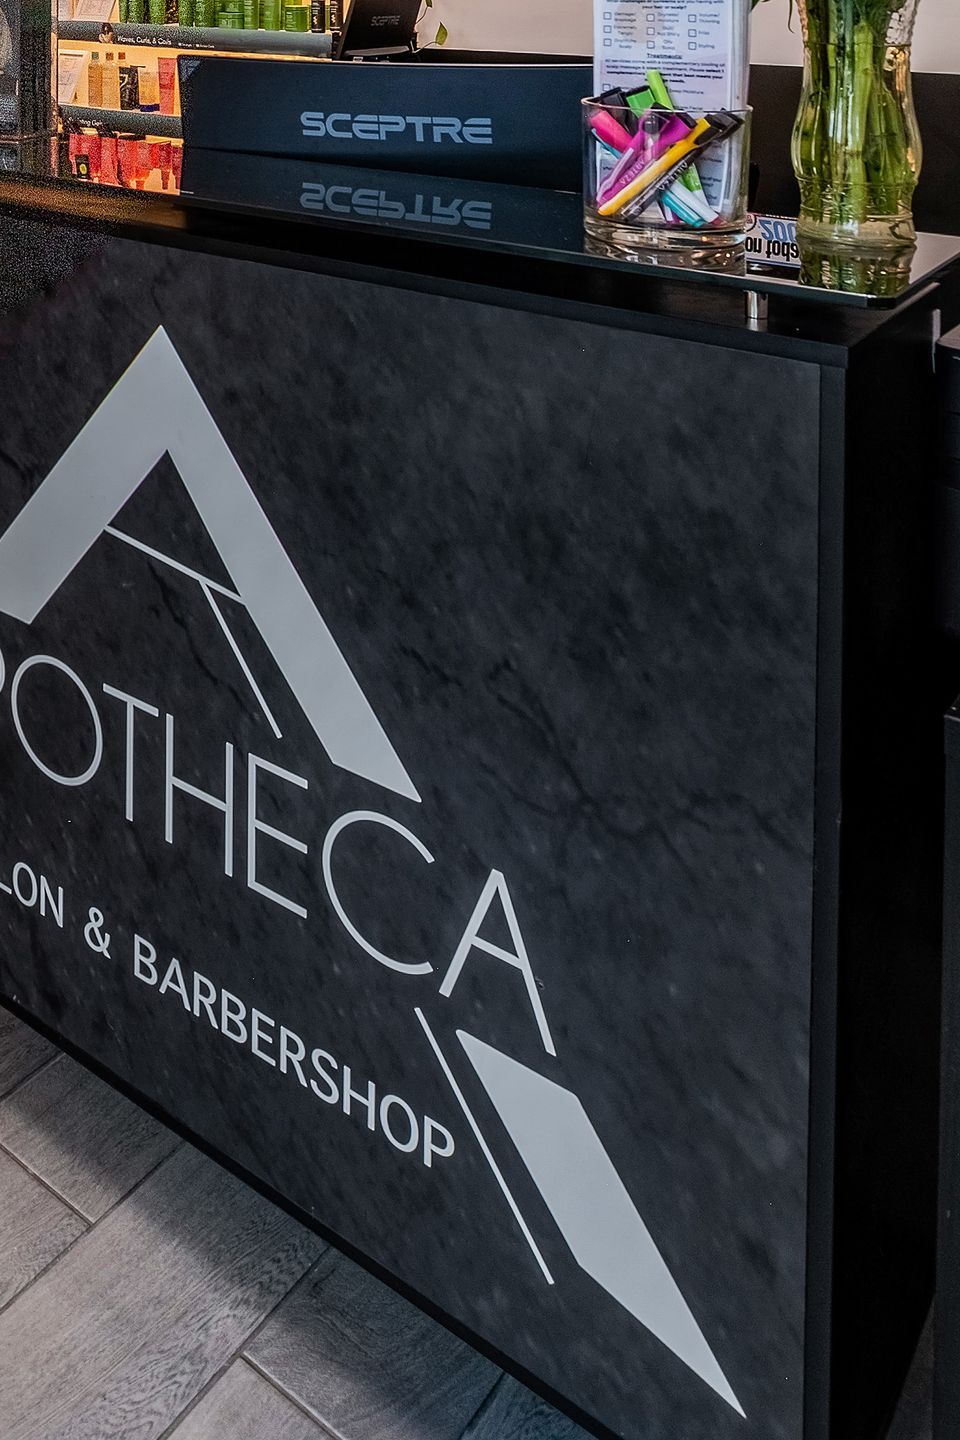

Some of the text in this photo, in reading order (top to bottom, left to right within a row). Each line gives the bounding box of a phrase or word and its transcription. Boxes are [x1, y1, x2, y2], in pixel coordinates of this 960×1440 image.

[300, 111, 493, 145] SCEPTRE
[84, 905, 111, 959] &
[133, 933, 456, 1169] BARBERSHOP
